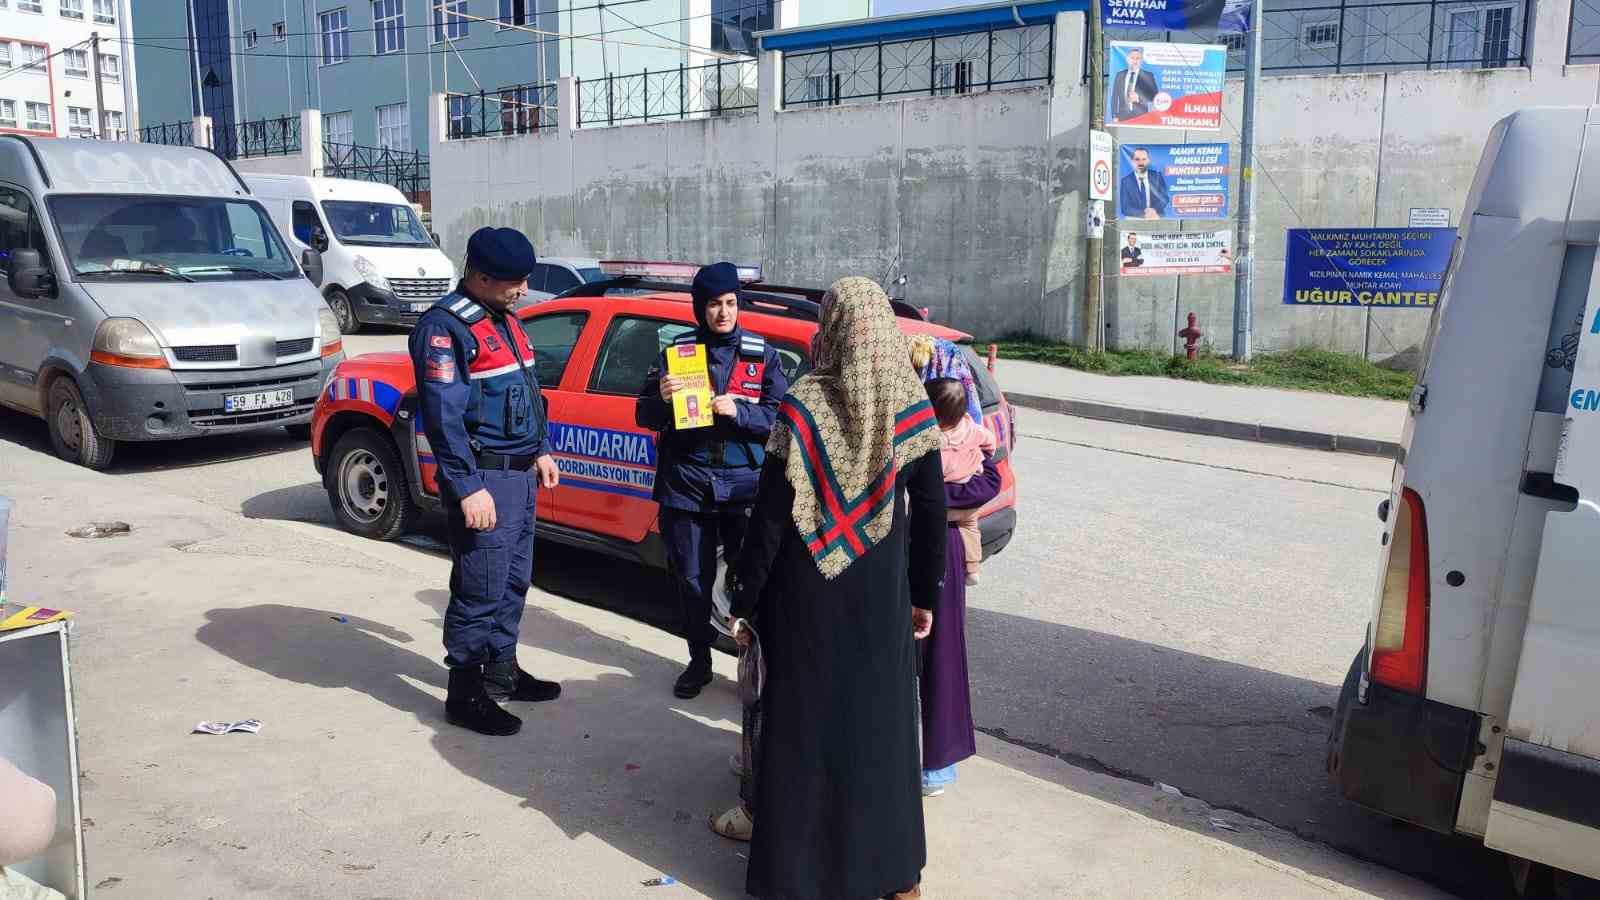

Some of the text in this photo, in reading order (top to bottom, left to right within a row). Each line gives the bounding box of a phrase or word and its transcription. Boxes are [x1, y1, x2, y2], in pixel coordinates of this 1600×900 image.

[1112, 8, 1145, 19] KAYA
[1097, 168, 1107, 186] 30
[1311, 232, 1350, 240] HALKIMIZ
[1327, 249, 1358, 257] ZAMAN
[1360, 249, 1425, 257] SOKAKLARINDA
[1348, 257, 1386, 266] GÖRECEK
[1347, 271, 1373, 279] NAMIK
[1374, 272, 1398, 280] KEMAL
[1295, 288, 1352, 303] UĞUR
[233, 390, 292, 407] 59 FA 428
[555, 426, 650, 465] JANDARMA
[554, 458, 630, 482] OORDİNASYON
